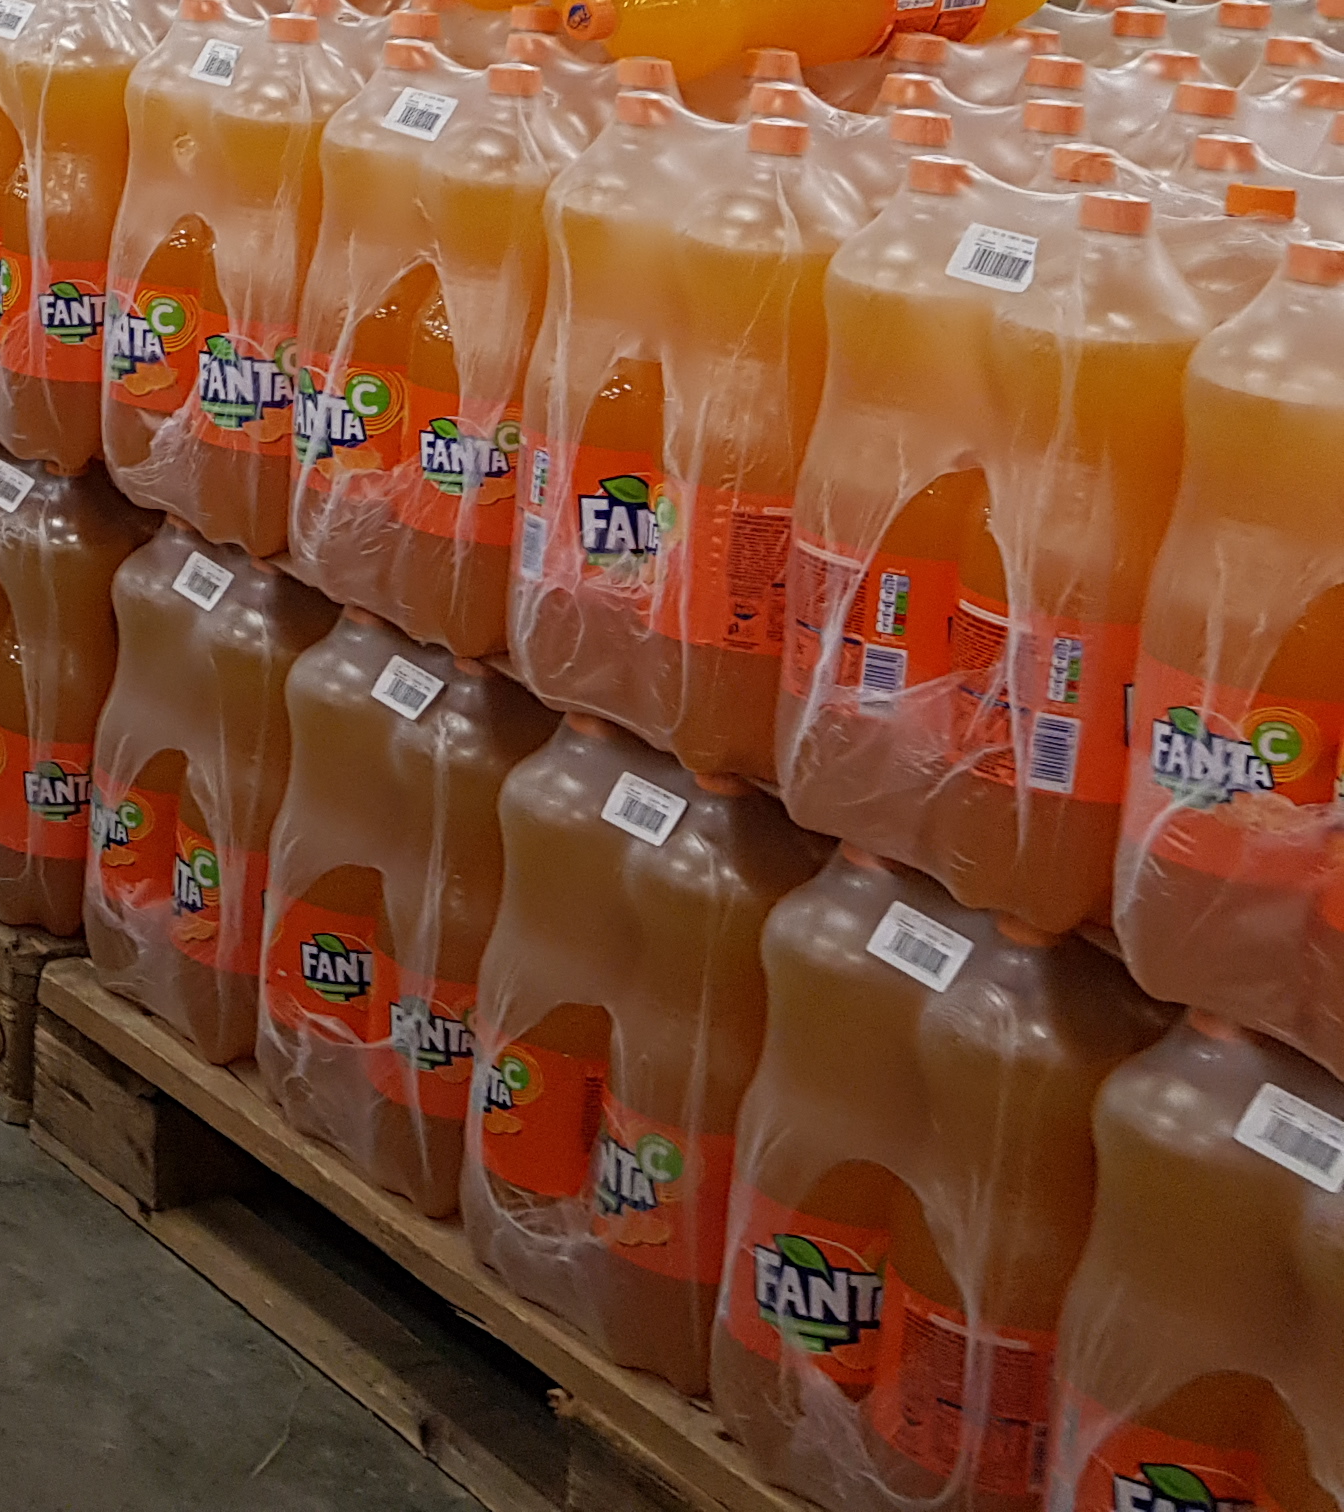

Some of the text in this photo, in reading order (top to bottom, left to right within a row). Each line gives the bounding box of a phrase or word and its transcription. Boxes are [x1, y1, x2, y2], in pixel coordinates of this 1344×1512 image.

[39, 294, 105, 328] FANT
[199, 352, 293, 403] FANTA
[294, 393, 366, 441] ANTA
[419, 431, 510, 473] FANTA
[24, 772, 91, 804] FANT
[300, 943, 373, 985] FANT
[754, 1245, 880, 1324] FANT
